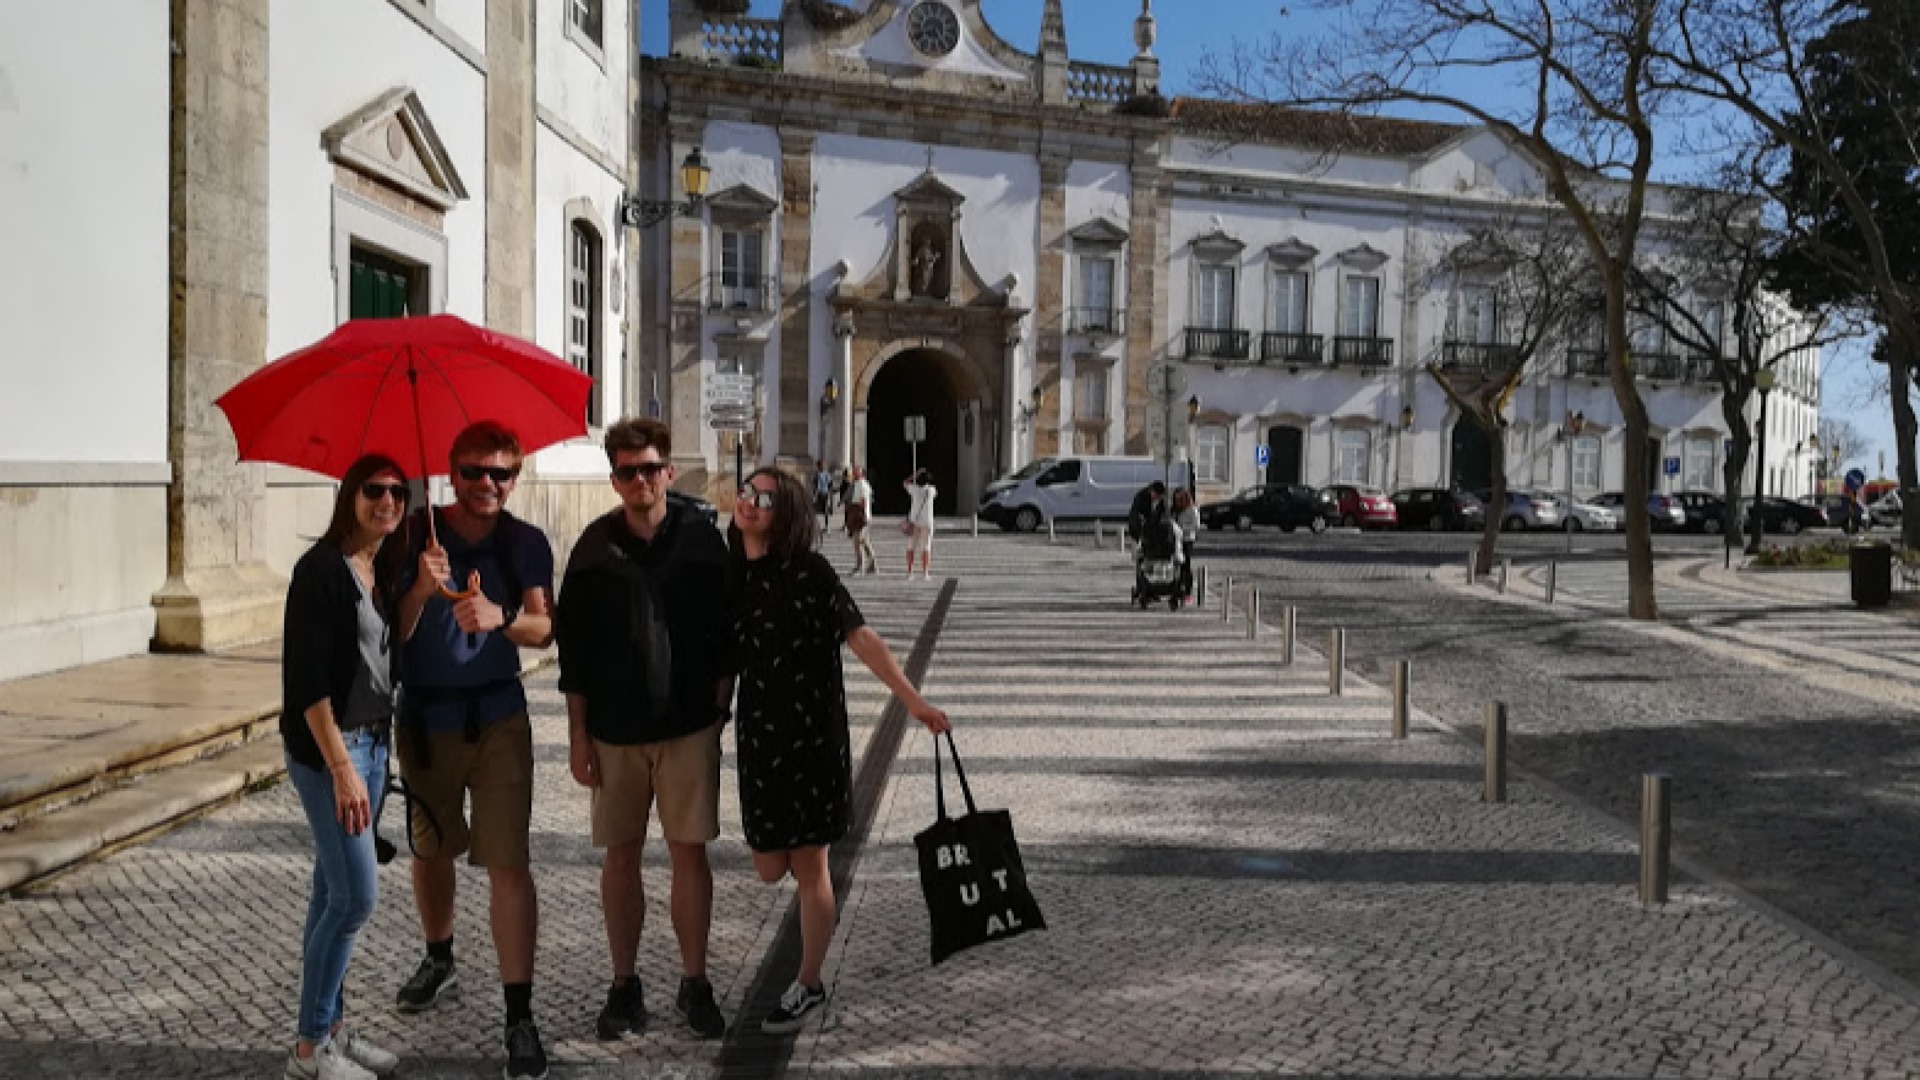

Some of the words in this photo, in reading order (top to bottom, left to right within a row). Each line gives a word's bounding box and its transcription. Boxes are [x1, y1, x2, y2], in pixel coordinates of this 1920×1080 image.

[937, 844, 972, 870] BR
[991, 867, 1007, 892] T
[959, 882, 980, 906] U
[986, 908, 1022, 936] AL
